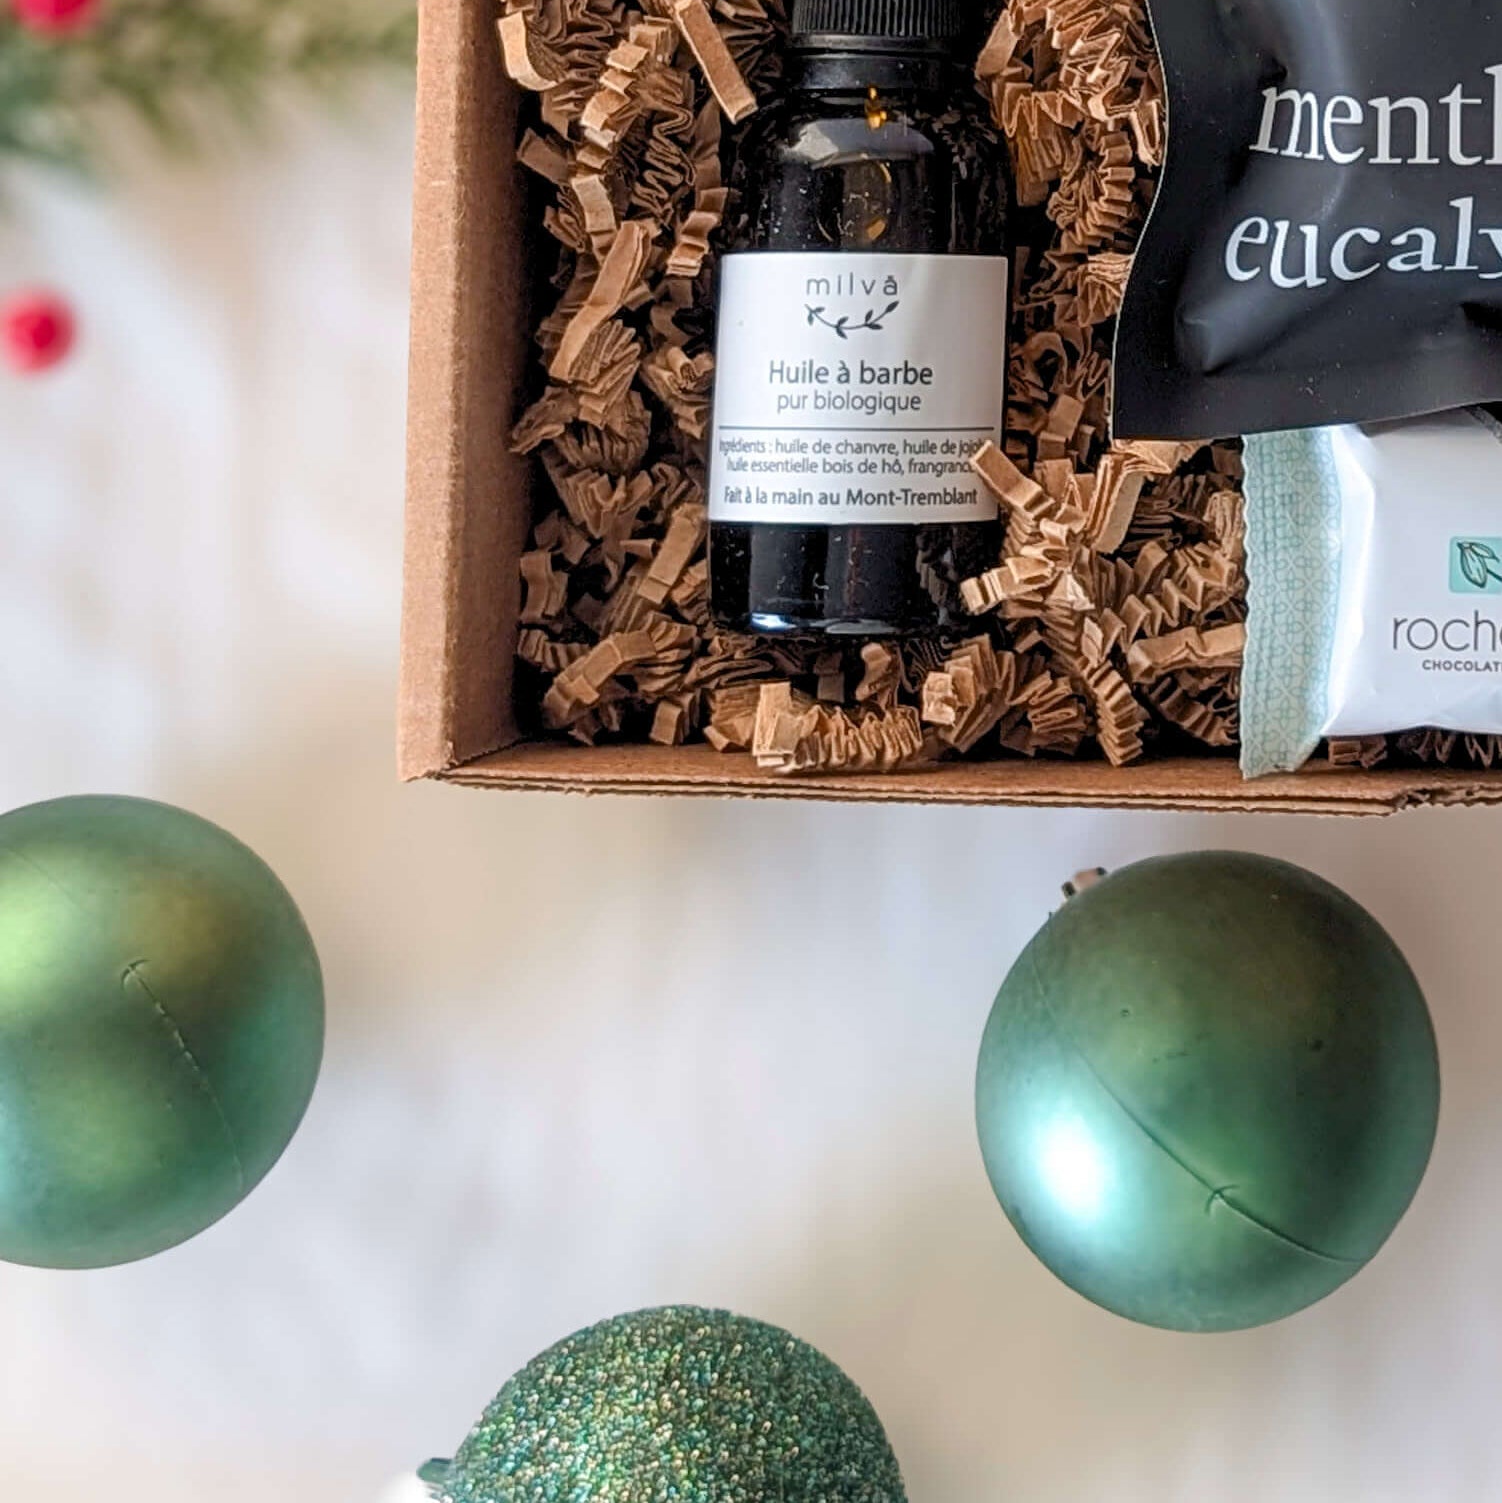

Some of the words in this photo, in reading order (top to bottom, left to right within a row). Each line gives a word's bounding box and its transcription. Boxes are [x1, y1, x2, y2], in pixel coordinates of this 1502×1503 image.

[768, 360, 830, 385] Huile
[835, 360, 851, 385] à
[859, 360, 933, 385] barbe
[777, 392, 809, 414] pur
[813, 389, 922, 415] biologique
[775, 438, 808, 454] huile
[812, 438, 832, 454] de
[835, 439, 899, 456] chanvre,
[903, 439, 937, 455] huile
[941, 438, 957, 455] de
[751, 457, 819, 473] essentielle
[822, 457, 854, 474] bois
[857, 458, 878, 474] de
[724, 486, 742, 504] Fait
[745, 485, 752, 504] à
[756, 486, 767, 504] la
[772, 487, 813, 505] main
[818, 491, 841, 505] au
[846, 487, 977, 506] Mont-Tremblant
